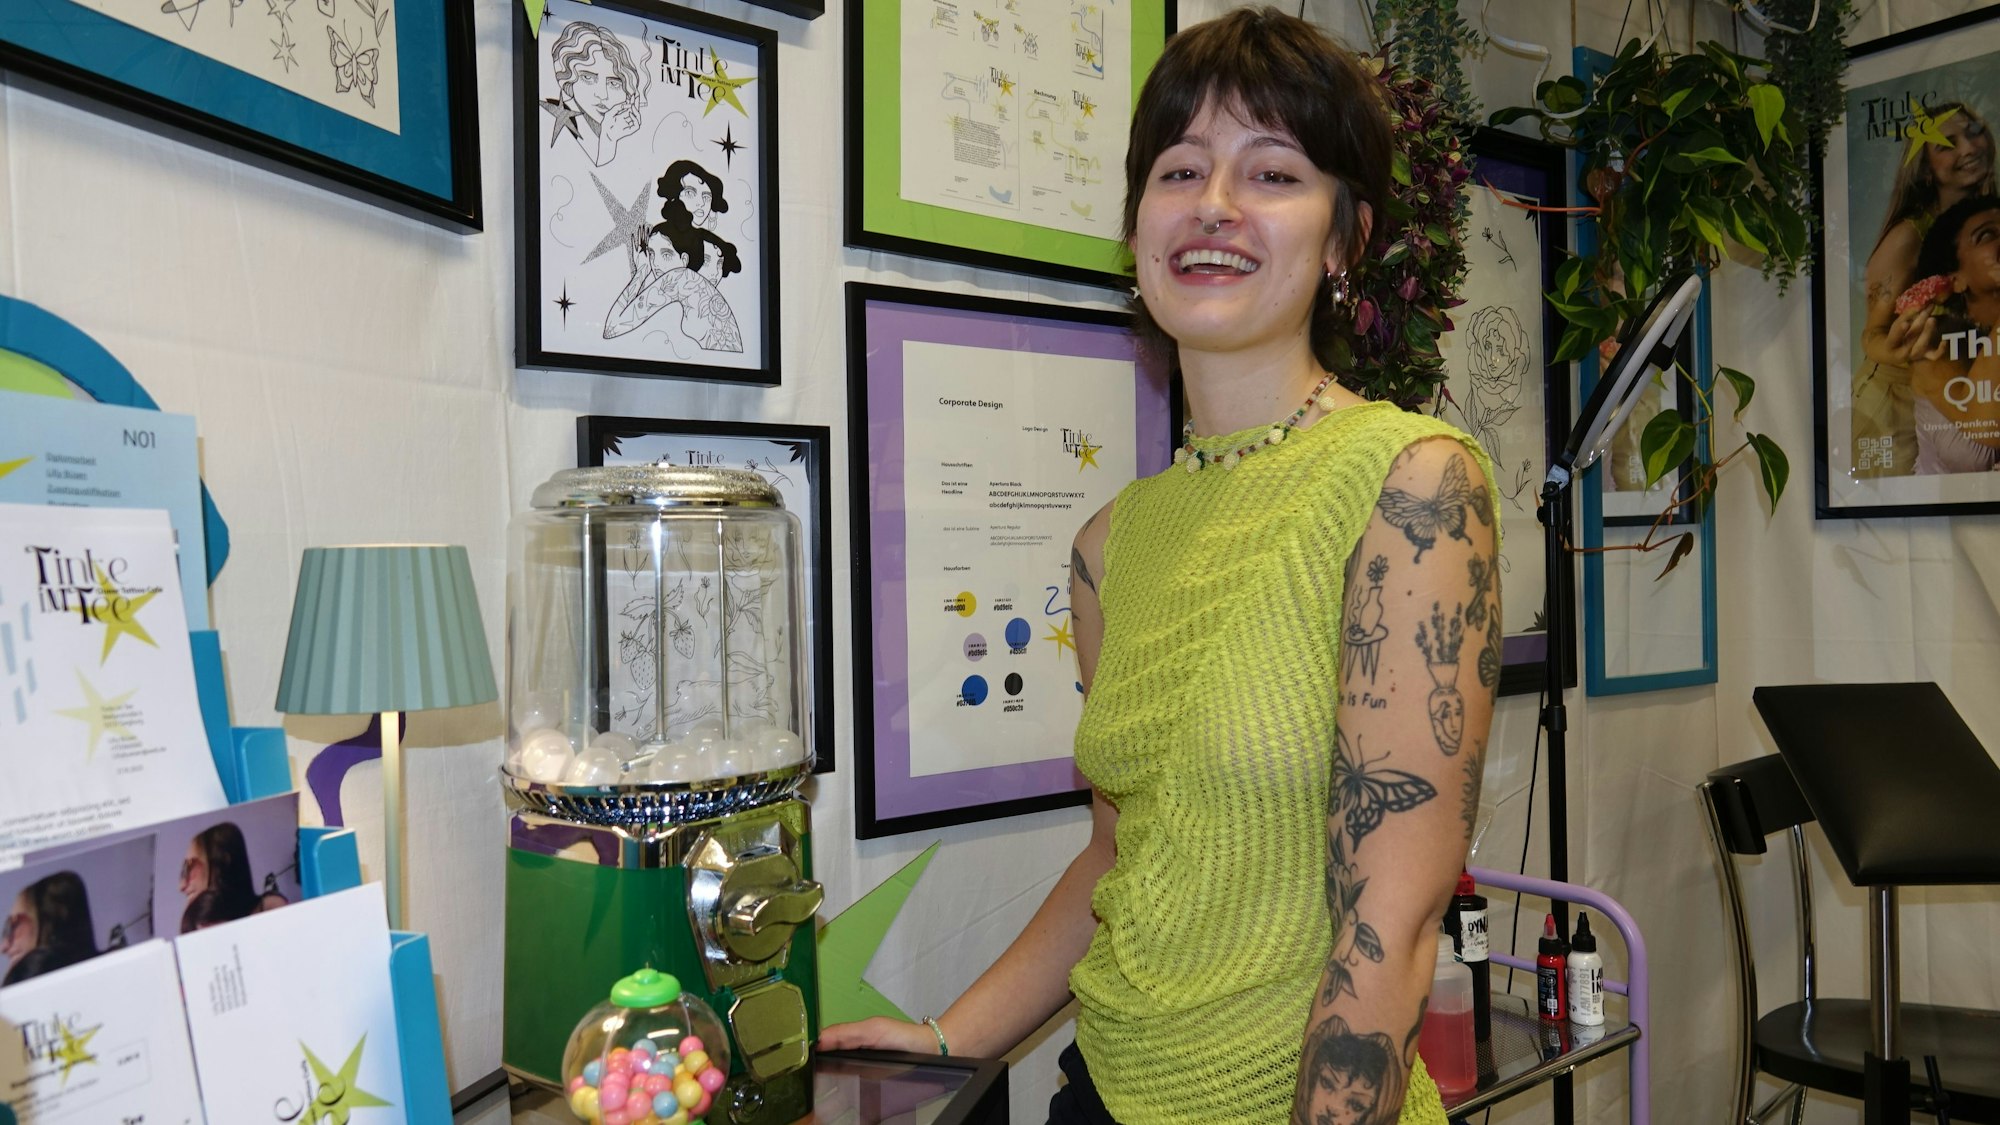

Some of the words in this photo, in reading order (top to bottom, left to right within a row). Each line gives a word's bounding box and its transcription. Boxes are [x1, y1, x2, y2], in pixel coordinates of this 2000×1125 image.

[655, 35, 728, 78] Tinte
[1034, 89, 1056, 101] Rechnung
[939, 398, 977, 408] Corporate
[978, 400, 1003, 409] Design
[1955, 419, 1998, 429] Denken,
[685, 450, 724, 465] Tinte
[989, 491, 1085, 499] ABCDEFGHIJKLMNOPQRSTUVWXYZ
[25, 545, 130, 585] Tinte
[1361, 692, 1387, 709] Fun
[1468, 914, 1488, 933] DYN
